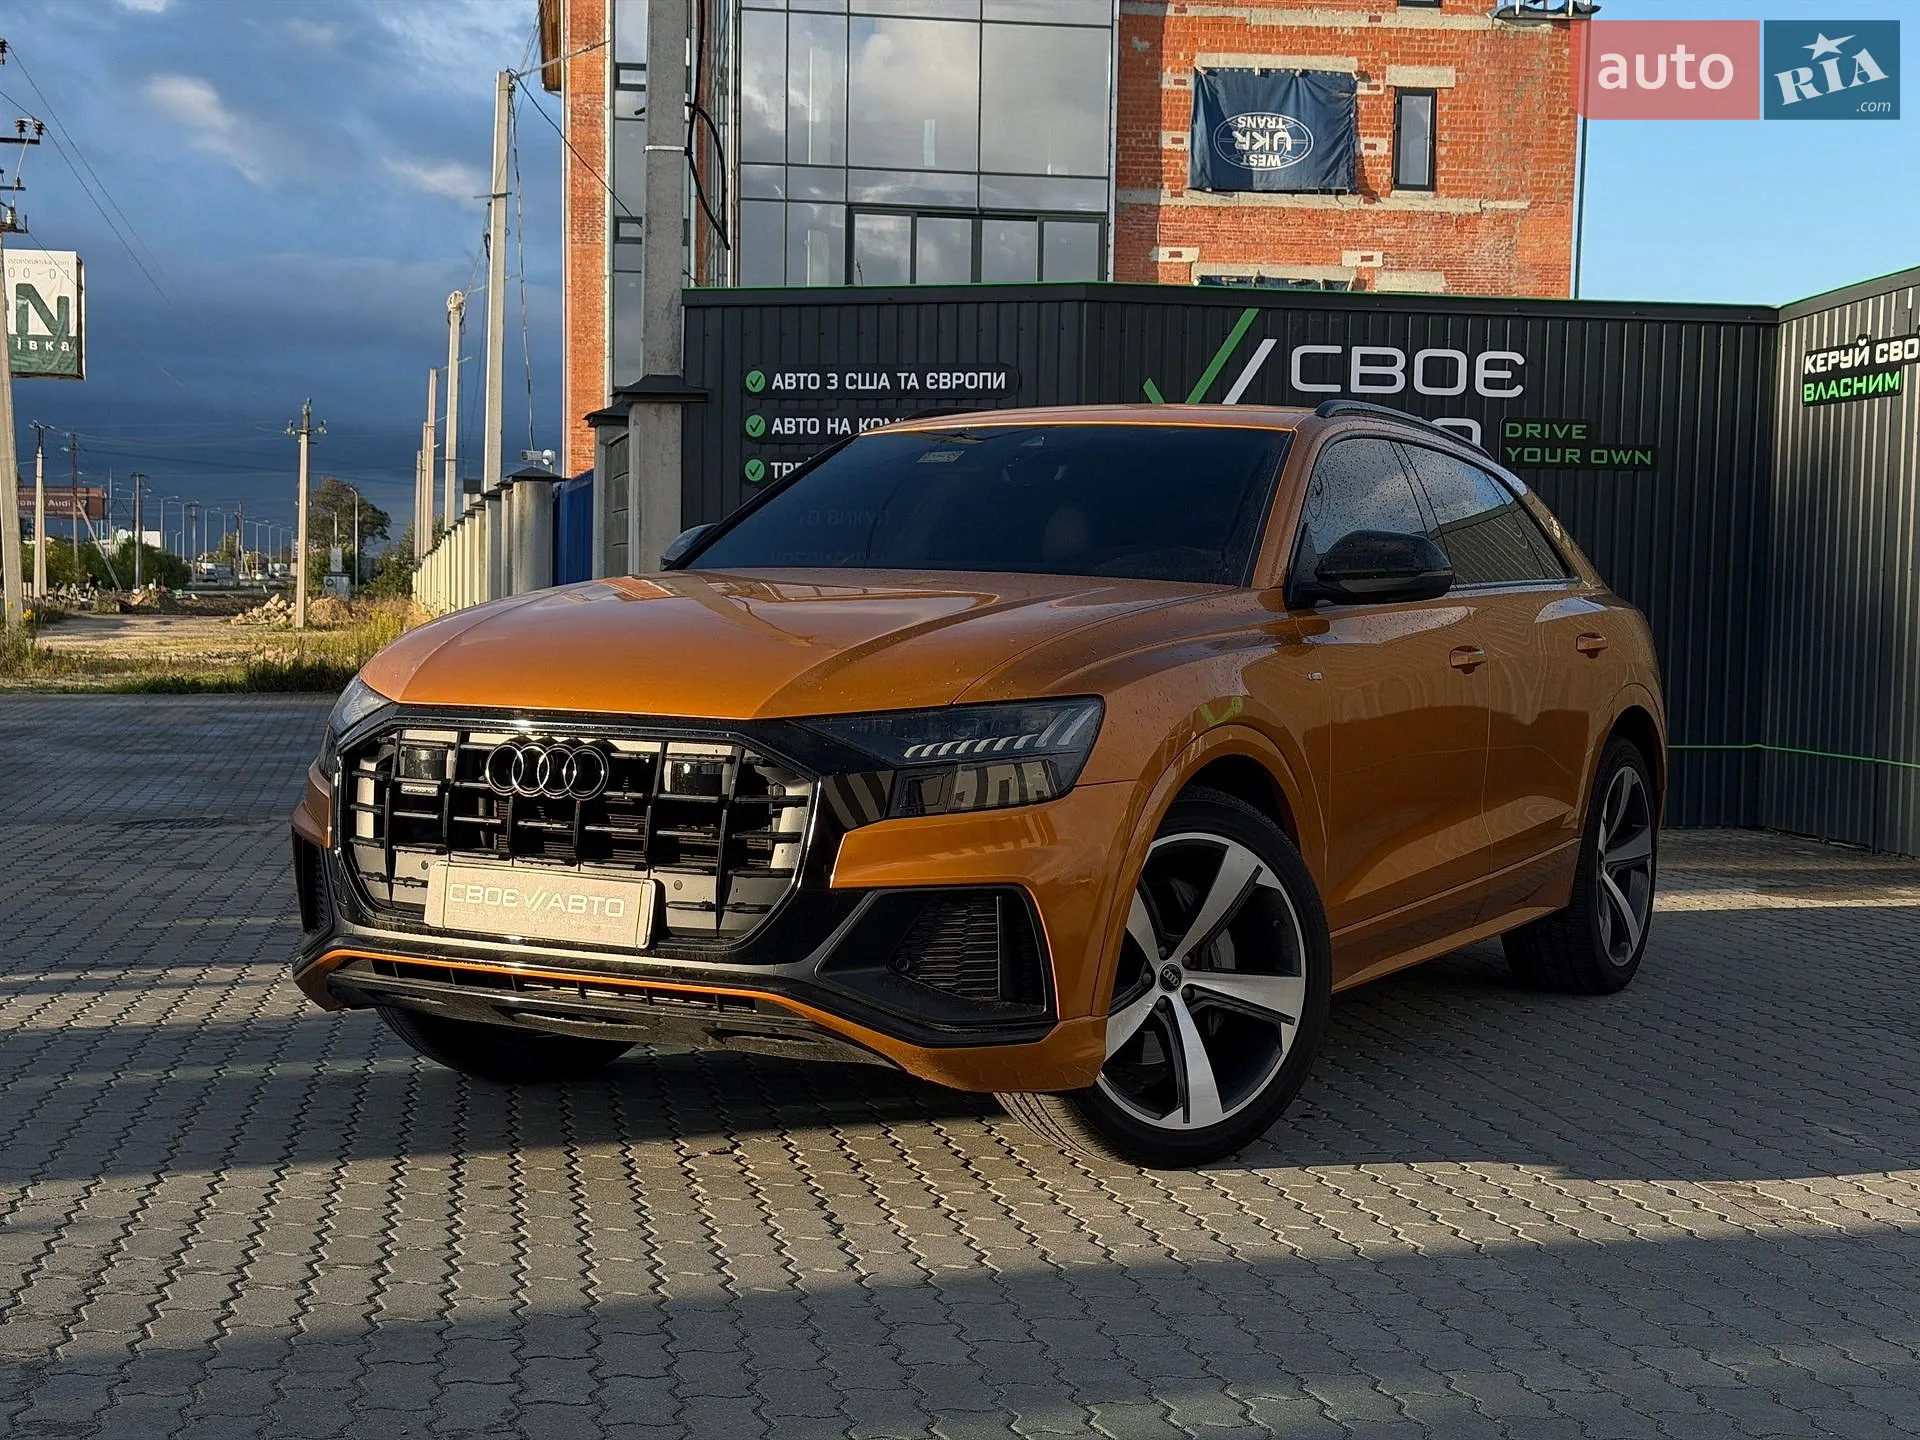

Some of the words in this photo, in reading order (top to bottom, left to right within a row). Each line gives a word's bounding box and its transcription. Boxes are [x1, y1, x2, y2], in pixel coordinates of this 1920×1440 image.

[1237, 116, 1286, 128] TRANS
[1232, 131, 1292, 151] UKR
[1240, 153, 1281, 167] WEST
[1804, 338, 1870, 375] КЕРУЙ
[1875, 337, 1920, 364] СВО
[771, 372, 820, 391] АВТО
[845, 372, 891, 391] США
[897, 372, 919, 390] ТА
[927, 371, 1006, 391] ЄВРОПИ
[1291, 345, 1526, 398] СВОЄ
[1803, 370, 1900, 402] ВЛАСНИМ
[771, 417, 820, 435] АВТО
[827, 417, 852, 435] НА
[1505, 422, 1587, 440] DRIVE
[1505, 447, 1581, 464] YOUR
[1590, 448, 1651, 465] OWN
[546, 893, 625, 917] АВТО
